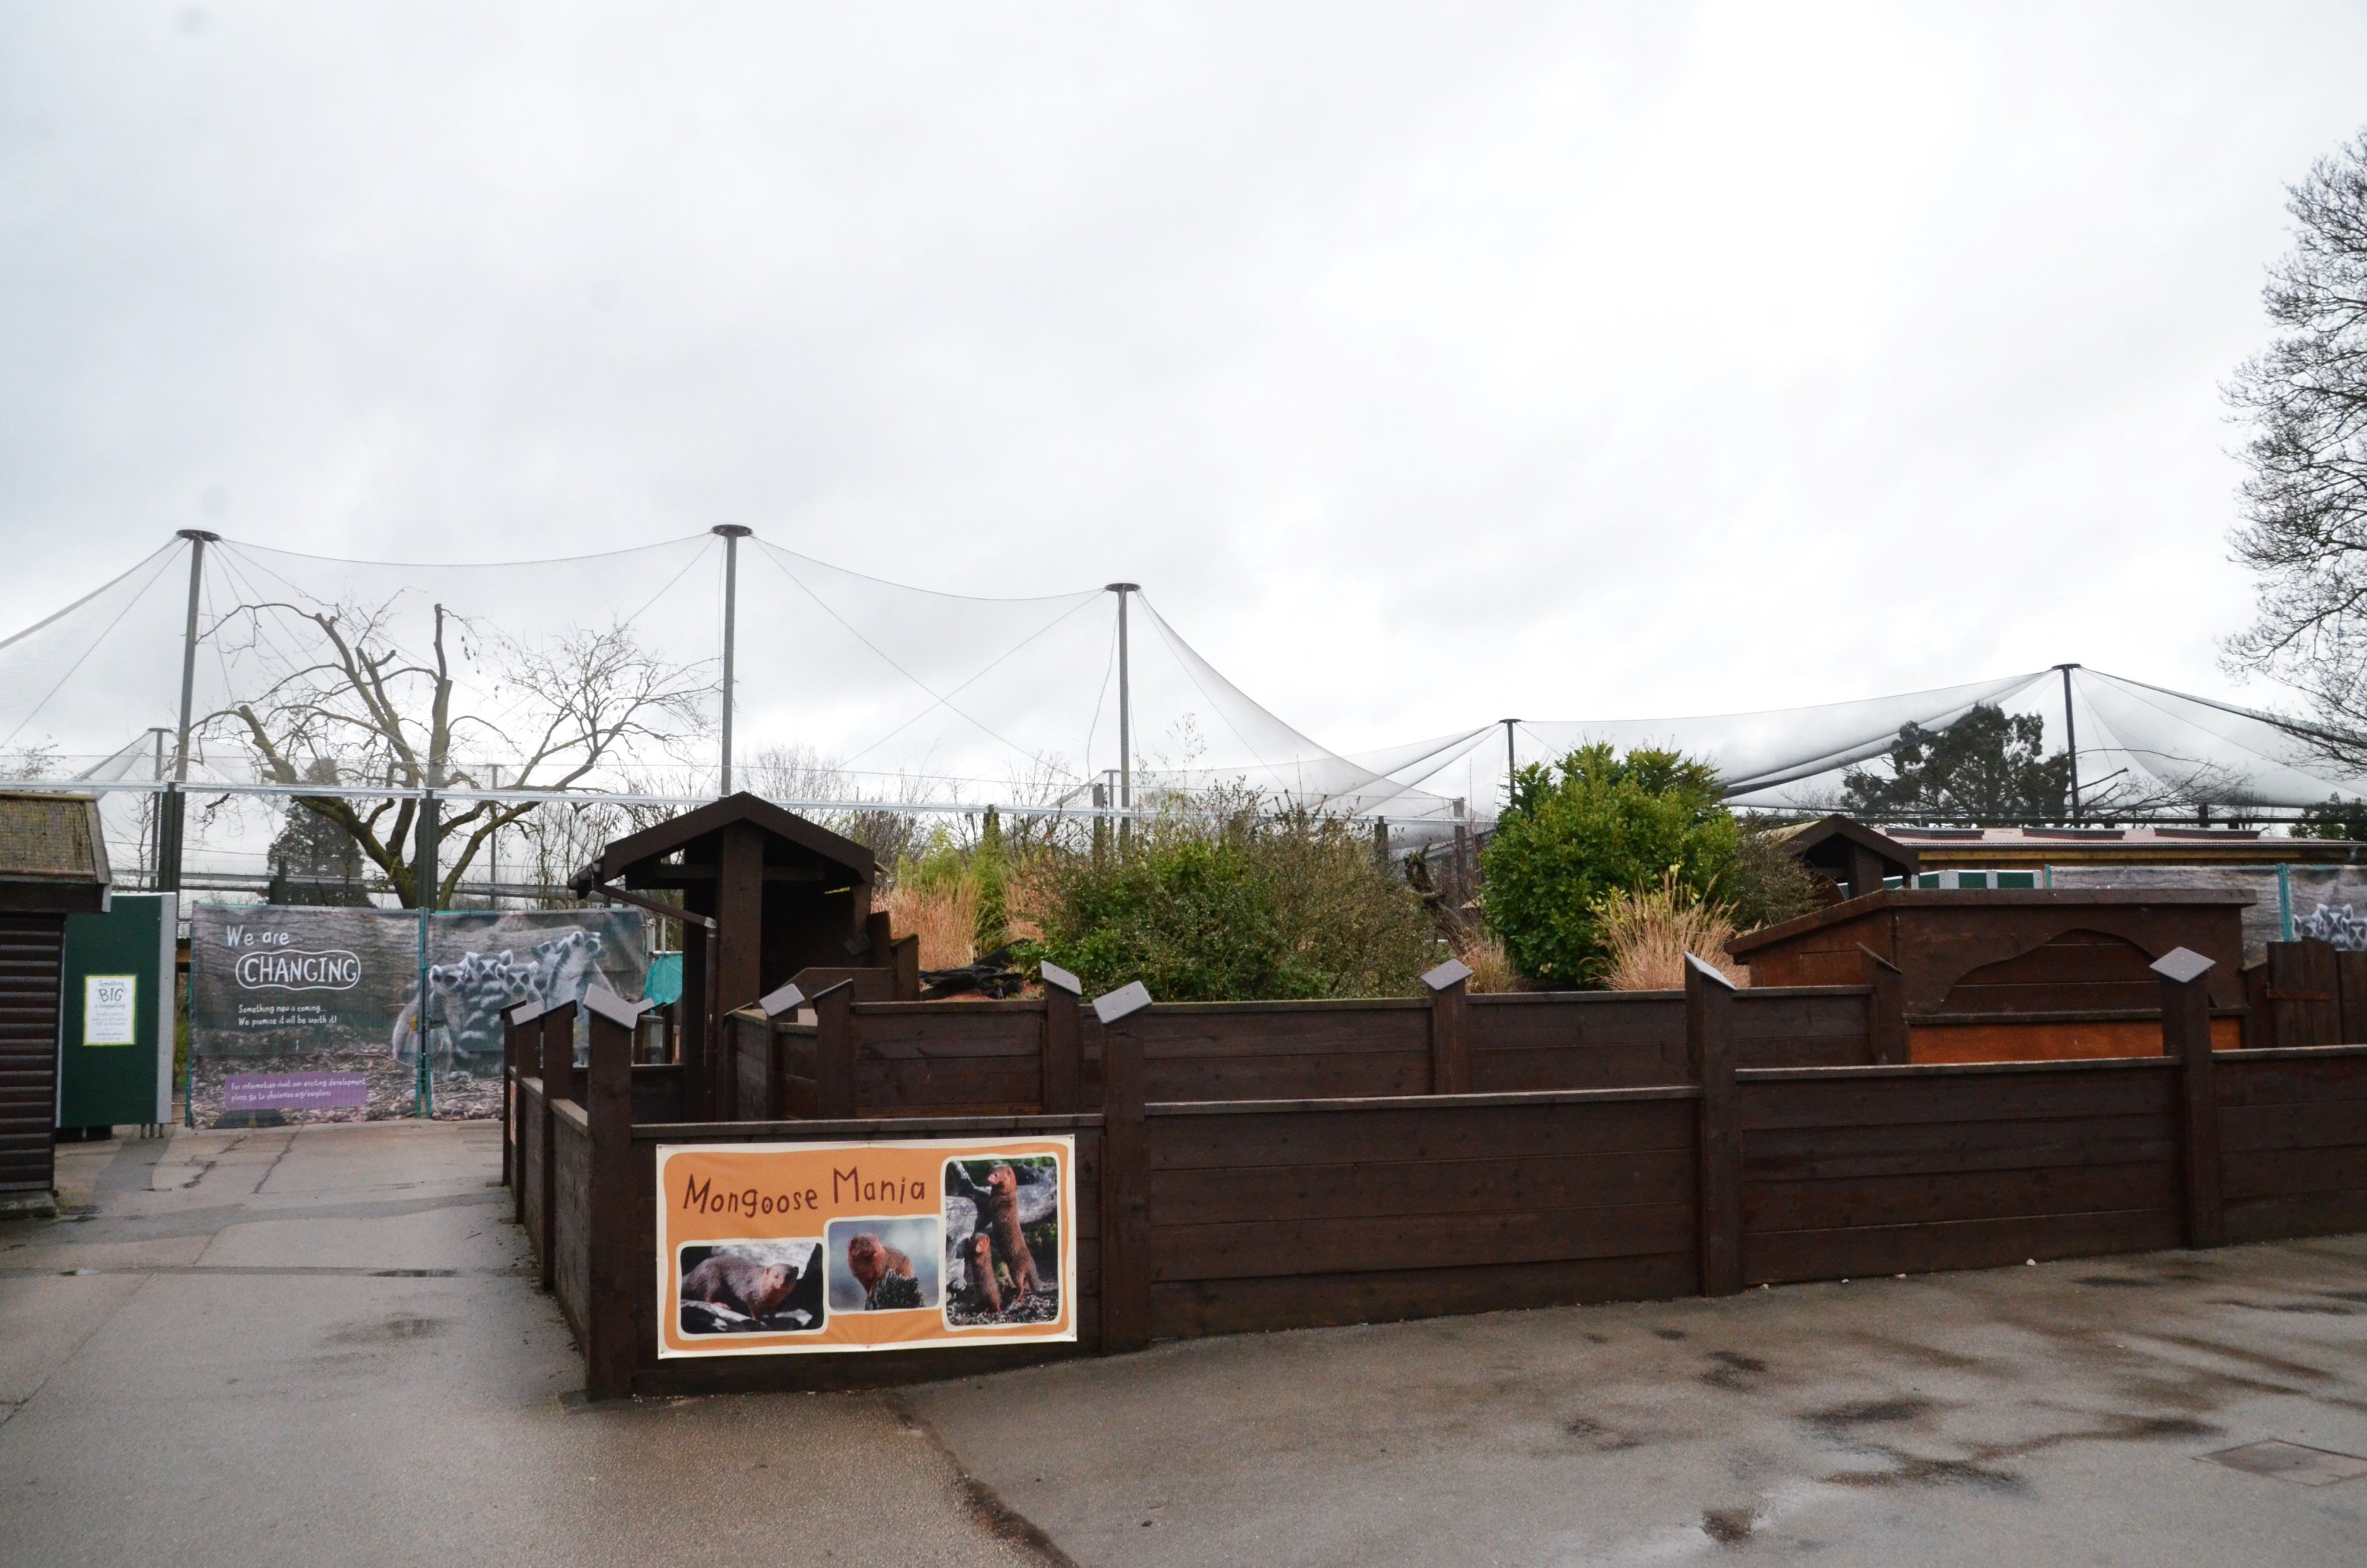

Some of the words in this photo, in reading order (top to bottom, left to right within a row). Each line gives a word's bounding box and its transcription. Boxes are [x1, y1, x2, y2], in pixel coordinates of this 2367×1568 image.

[226, 925, 255, 947] We
[262, 931, 290, 946] are
[244, 955, 357, 983] CHANGING
[98, 987, 124, 1003] BIG
[238, 1003, 274, 1014] Something
[238, 1016, 250, 1026] We
[252, 1018, 277, 1027] promise
[279, 1015, 285, 1024] it
[285, 1015, 296, 1024] will
[297, 1013, 306, 1024] be
[308, 1014, 327, 1024] worth
[329, 1015, 338, 1024] it!
[231, 1082, 240, 1090] For
[242, 1080, 276, 1090] information
[682, 1173, 819, 1218] Mongoose
[833, 1166, 925, 1204] Mania
